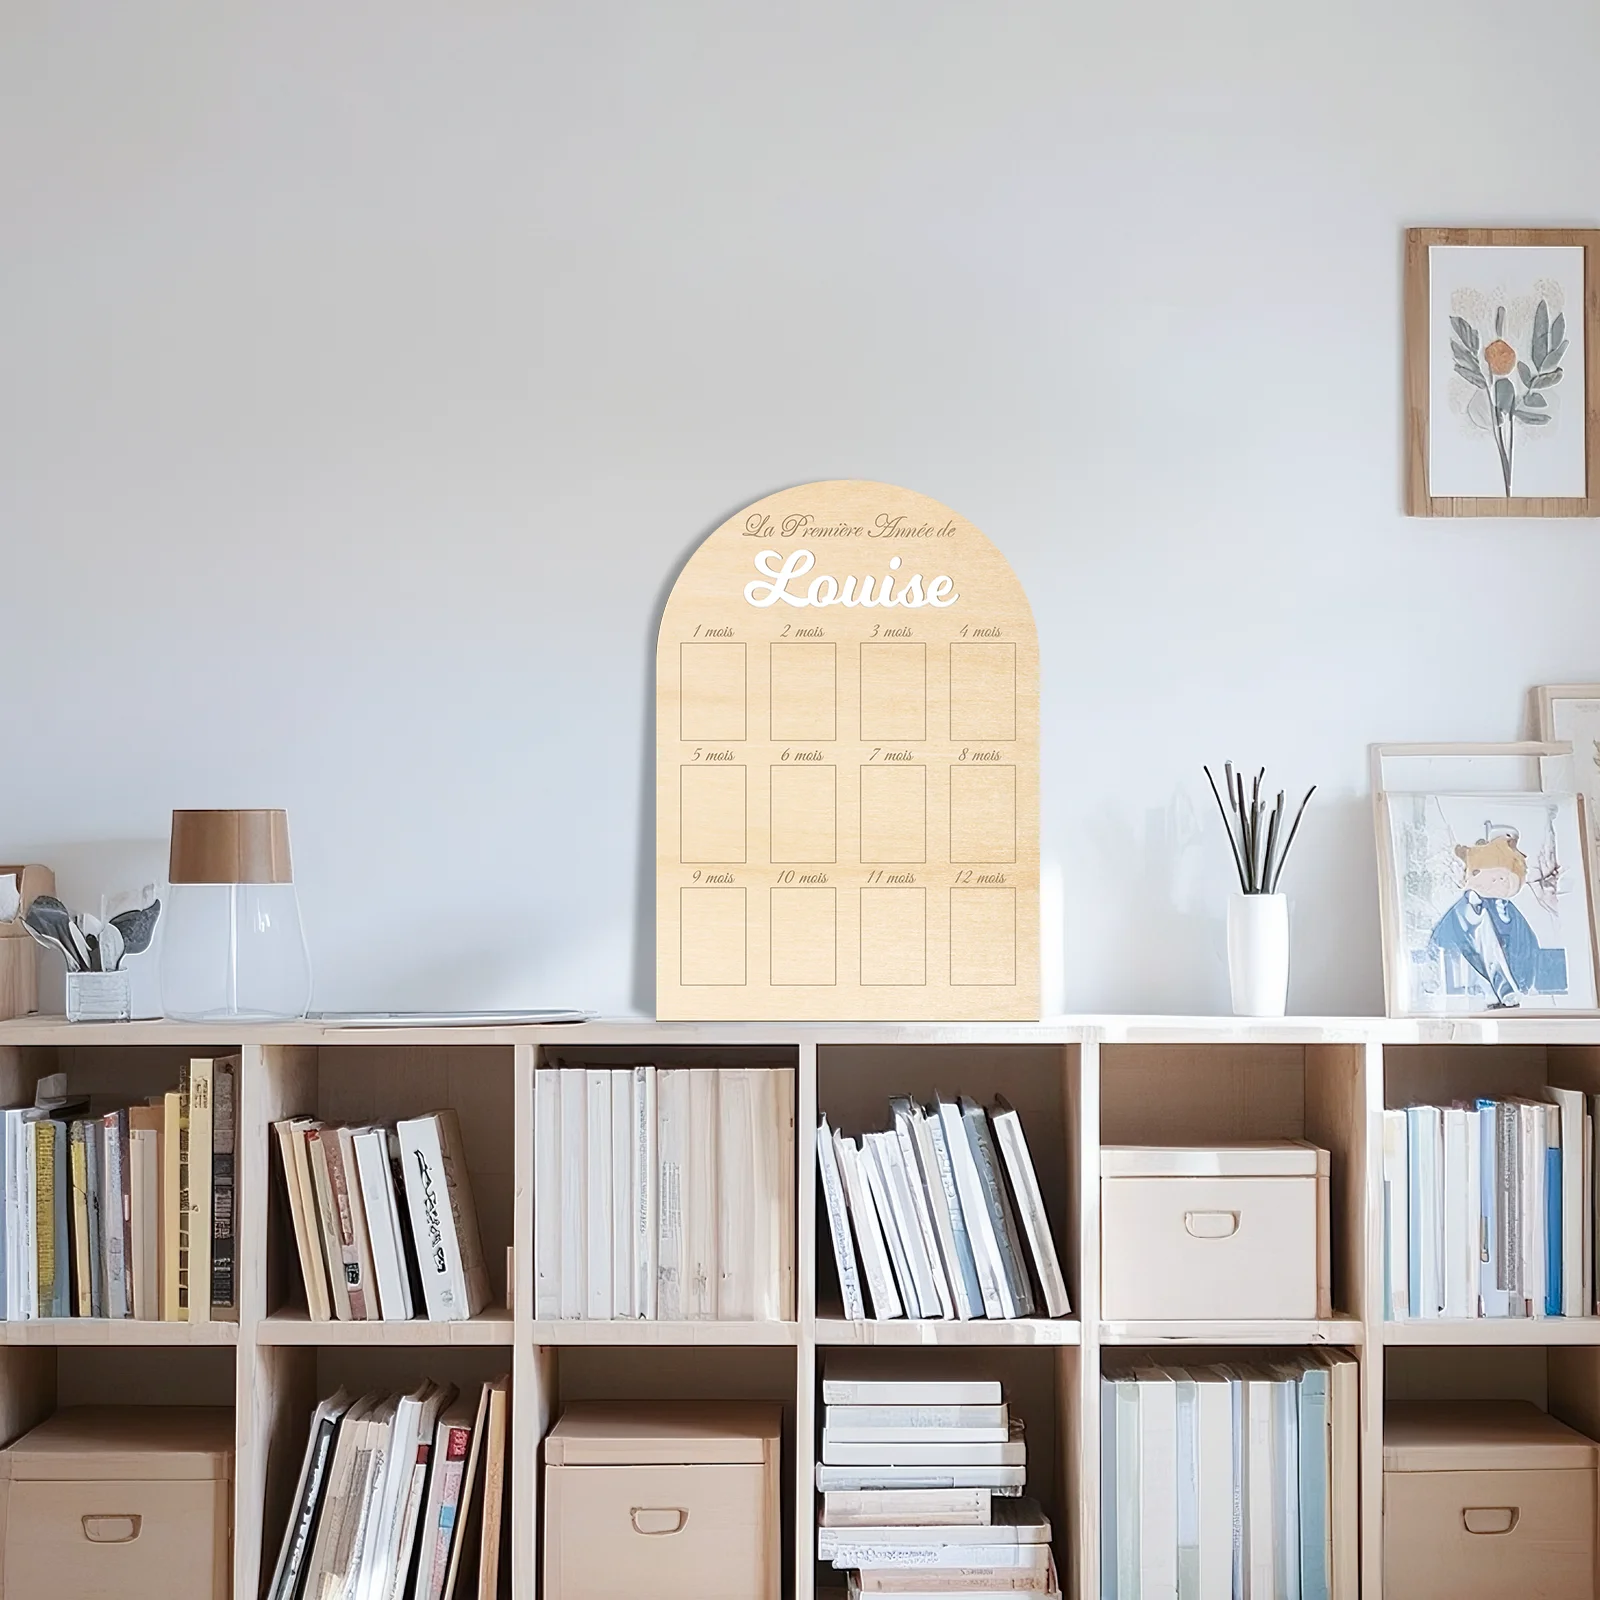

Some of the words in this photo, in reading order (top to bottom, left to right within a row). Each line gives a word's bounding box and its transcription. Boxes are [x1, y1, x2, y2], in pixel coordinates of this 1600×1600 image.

[742, 513, 775, 538] La
[781, 513, 864, 538] Première
[867, 512, 934, 538] Année
[936, 520, 957, 538] de
[743, 549, 960, 608] Louise
[692, 623, 702, 638] 1
[704, 625, 735, 638] mois
[779, 623, 791, 638] 2
[794, 625, 825, 638] mois
[869, 623, 880, 638] 3
[883, 625, 913, 638] mois
[959, 623, 969, 638] 4
[971, 625, 1002, 638] mois
[691, 747, 702, 762] 5
[704, 749, 735, 762] mois
[780, 747, 790, 762] 6
[793, 749, 824, 762] mois
[868, 747, 881, 762] 7
[883, 749, 914, 762] mois
[957, 747, 969, 762] 8
[971, 749, 1002, 762] mois
[692, 869, 702, 884] 9
[704, 871, 735, 884] mois
[776, 869, 795, 885] 10
[798, 871, 829, 885] mois
[866, 869, 883, 884] 11
[885, 871, 916, 884] mois
[954, 869, 973, 884] 12
[975, 871, 1007, 884] mois
